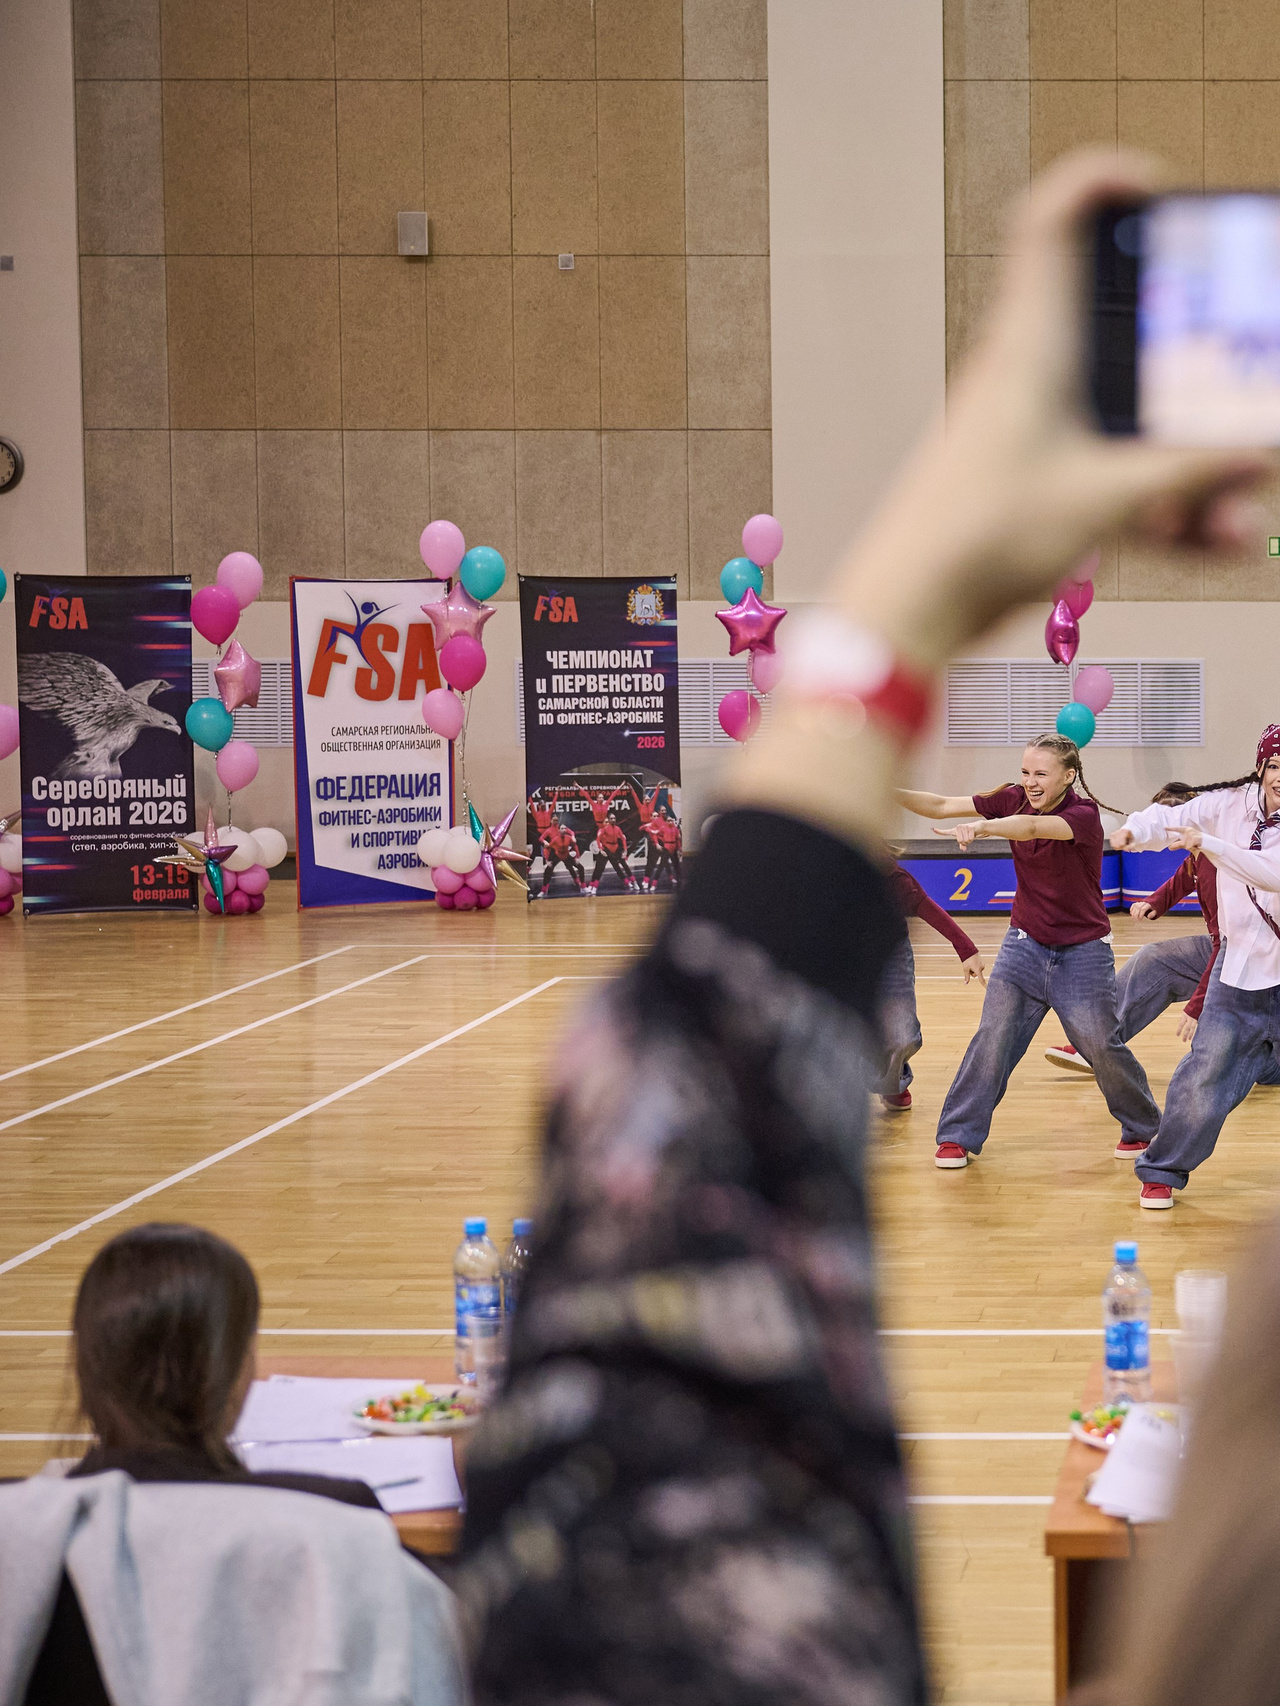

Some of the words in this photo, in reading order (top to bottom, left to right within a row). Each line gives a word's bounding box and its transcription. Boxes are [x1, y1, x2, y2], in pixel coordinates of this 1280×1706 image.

[29, 595, 88, 629] FSA
[534, 595, 579, 623] FSA
[307, 618, 442, 701] FSA
[546, 650, 654, 669] ЧЕМПИОНАТ
[536, 678, 546, 694] и
[552, 673, 664, 694] ПЕРВЕНСТВО
[538, 696, 609, 710] САМАРСКОЙ
[612, 696, 664, 709] ОБЛАСТИ
[539, 713, 554, 725] ПО
[557, 711, 664, 725] ФИТНЕС-АЭРОБИКЕ
[331, 726, 378, 737] САМАРСКАЯ
[320, 740, 384, 753] ОБЩЕСТВЕННАЯ
[386, 739, 441, 751] ОРГАНИЗАЦИЯ
[637, 736, 665, 749] 2026
[32, 774, 187, 804] Серебряный
[316, 772, 441, 802] ФЕДЕРАЦИЯ
[47, 805, 121, 831] орлан
[128, 801, 187, 825] 2026
[318, 806, 442, 826] ФИТНЕС-АЭРОБИКИ
[71, 843, 98, 852] (степ,
[101, 841, 147, 852] аэробика,
[351, 833, 360, 848] И
[377, 853, 429, 870] АЭРОБИ
[130, 864, 189, 885] 13-15
[949, 868, 972, 900] 2
[133, 888, 189, 902] февраля
